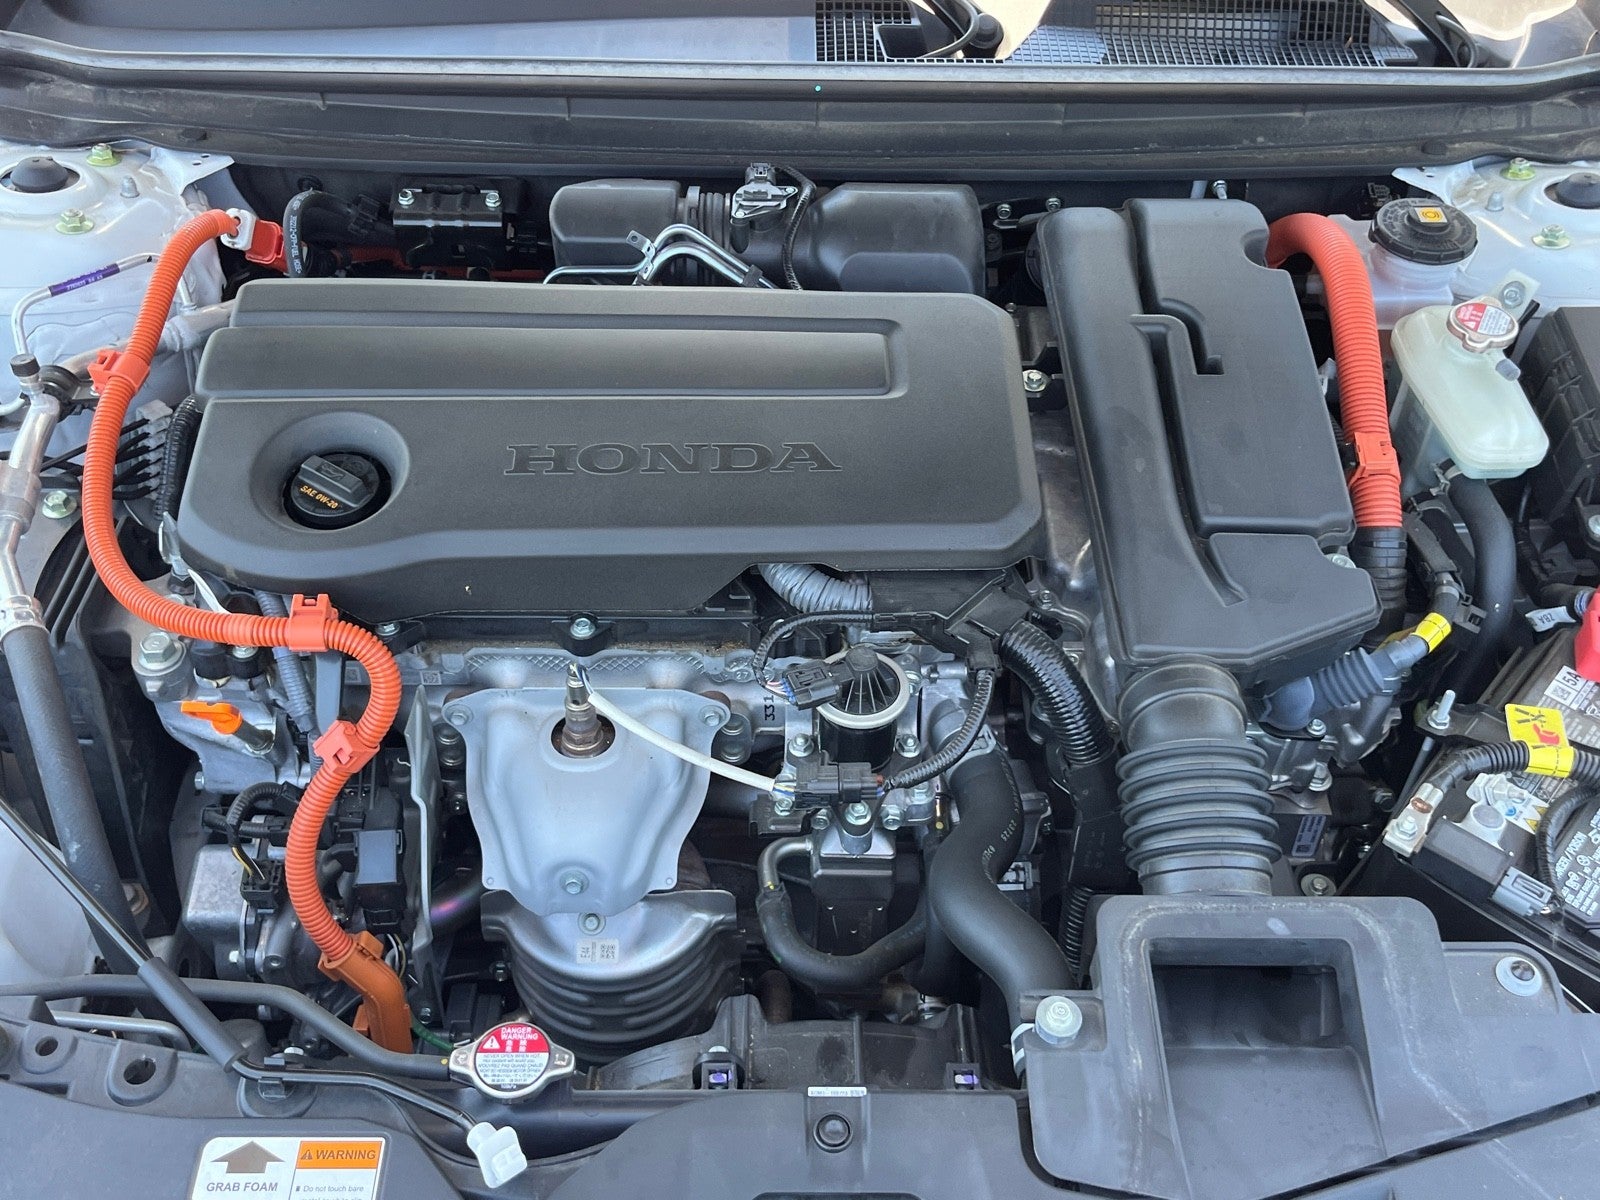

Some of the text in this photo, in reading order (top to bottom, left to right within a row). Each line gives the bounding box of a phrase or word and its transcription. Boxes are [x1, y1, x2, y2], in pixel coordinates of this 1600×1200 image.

[503, 442, 843, 476] HONDA
[300, 485, 339, 509] SAE 0W-20
[763, 695, 776, 721] 331
[500, 1026, 533, 1035] DANGER
[316, 1149, 377, 1160] WARNING
[206, 1182, 279, 1193] GRAB FOAM
